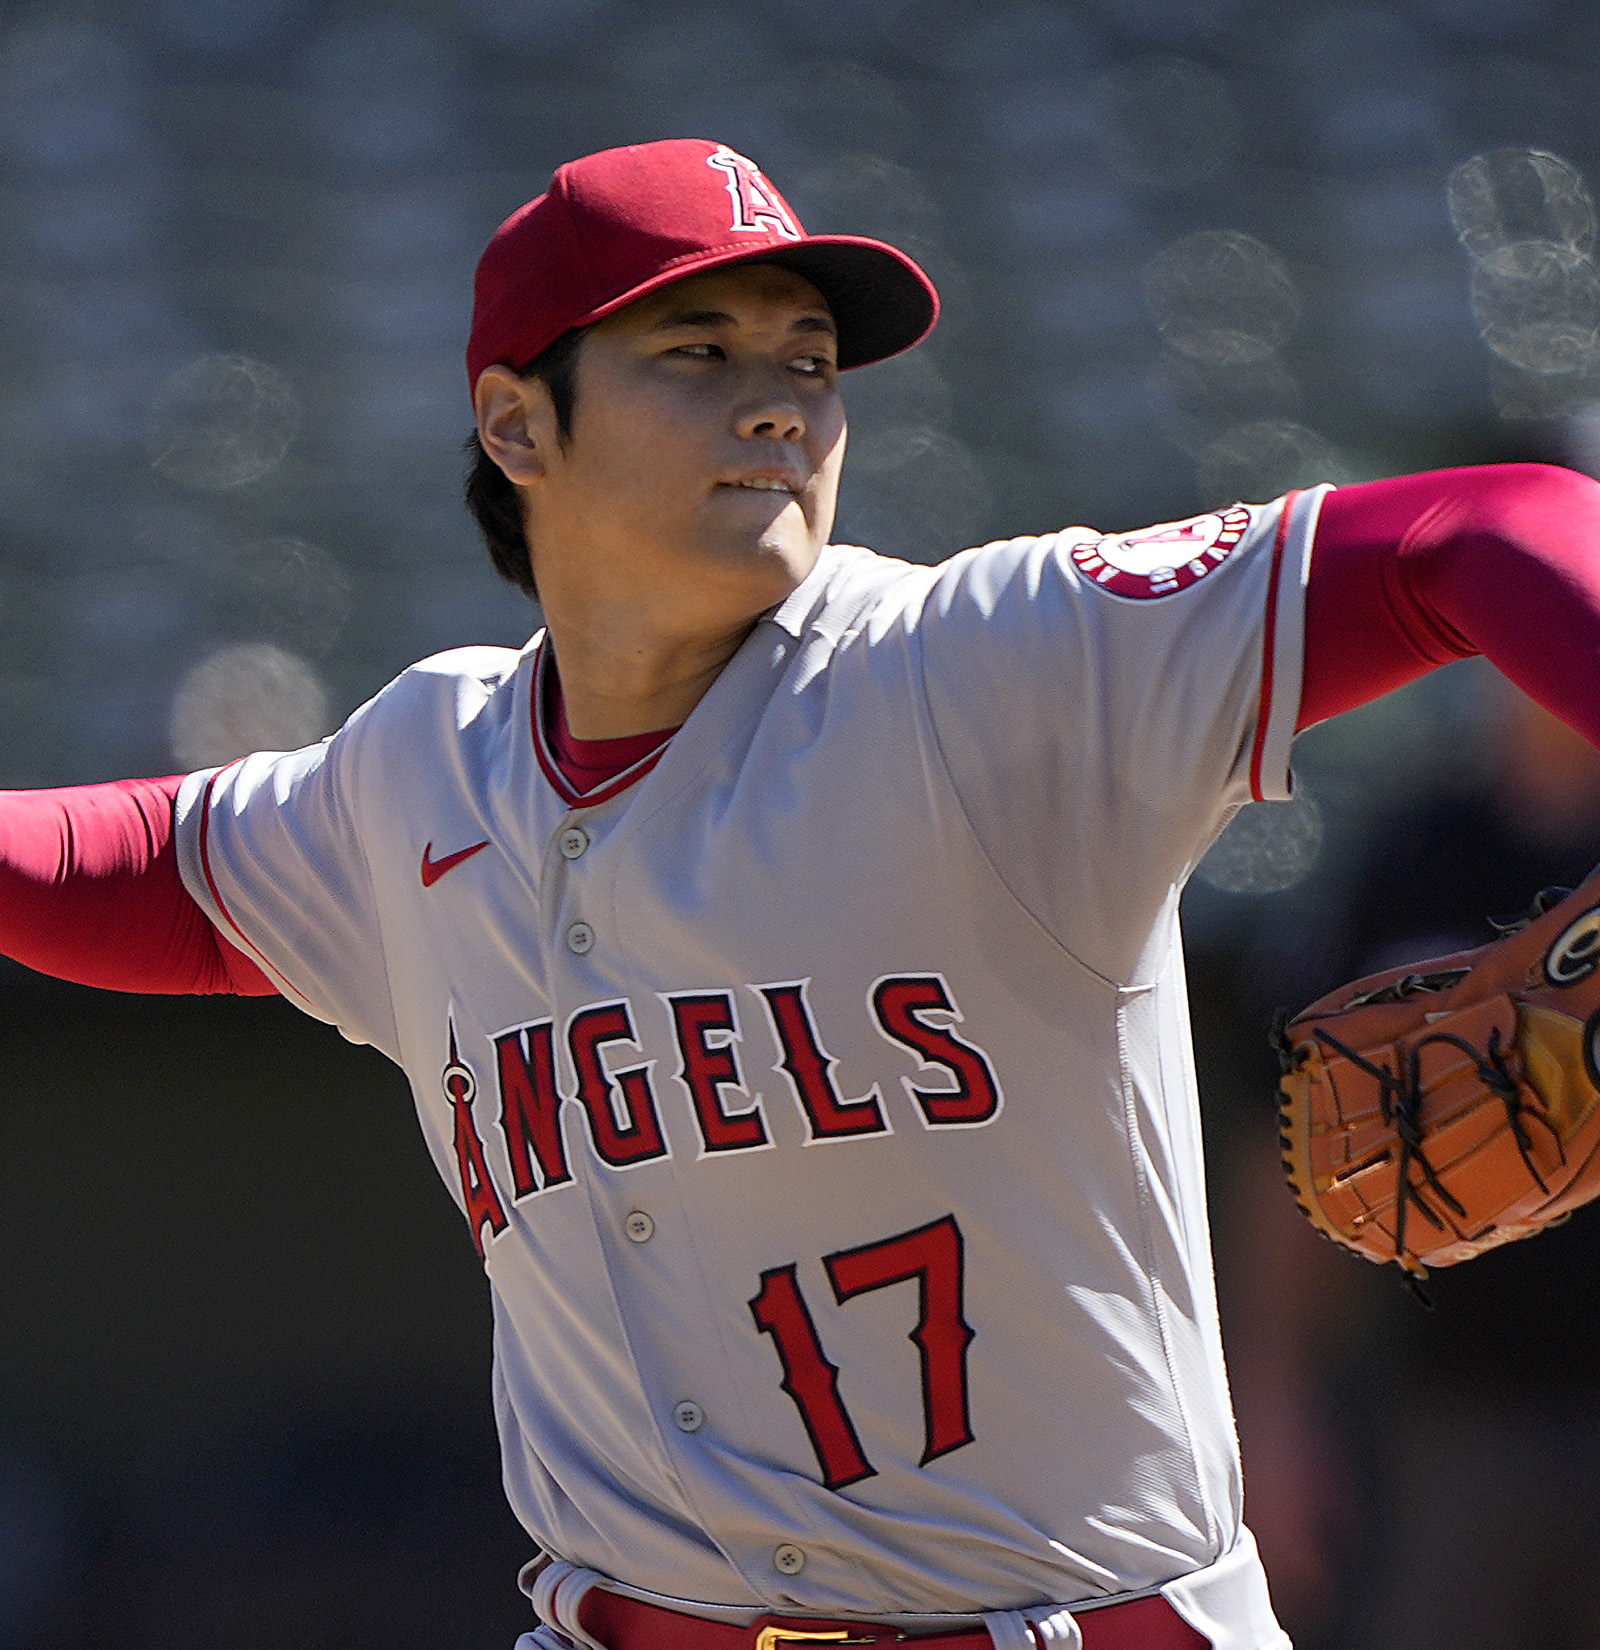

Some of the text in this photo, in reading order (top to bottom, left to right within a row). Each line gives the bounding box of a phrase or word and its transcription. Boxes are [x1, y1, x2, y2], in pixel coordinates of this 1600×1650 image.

[706, 144, 801, 241] A
[442, 973, 1004, 1278] ANGELS
[748, 1213, 976, 1492] 17
